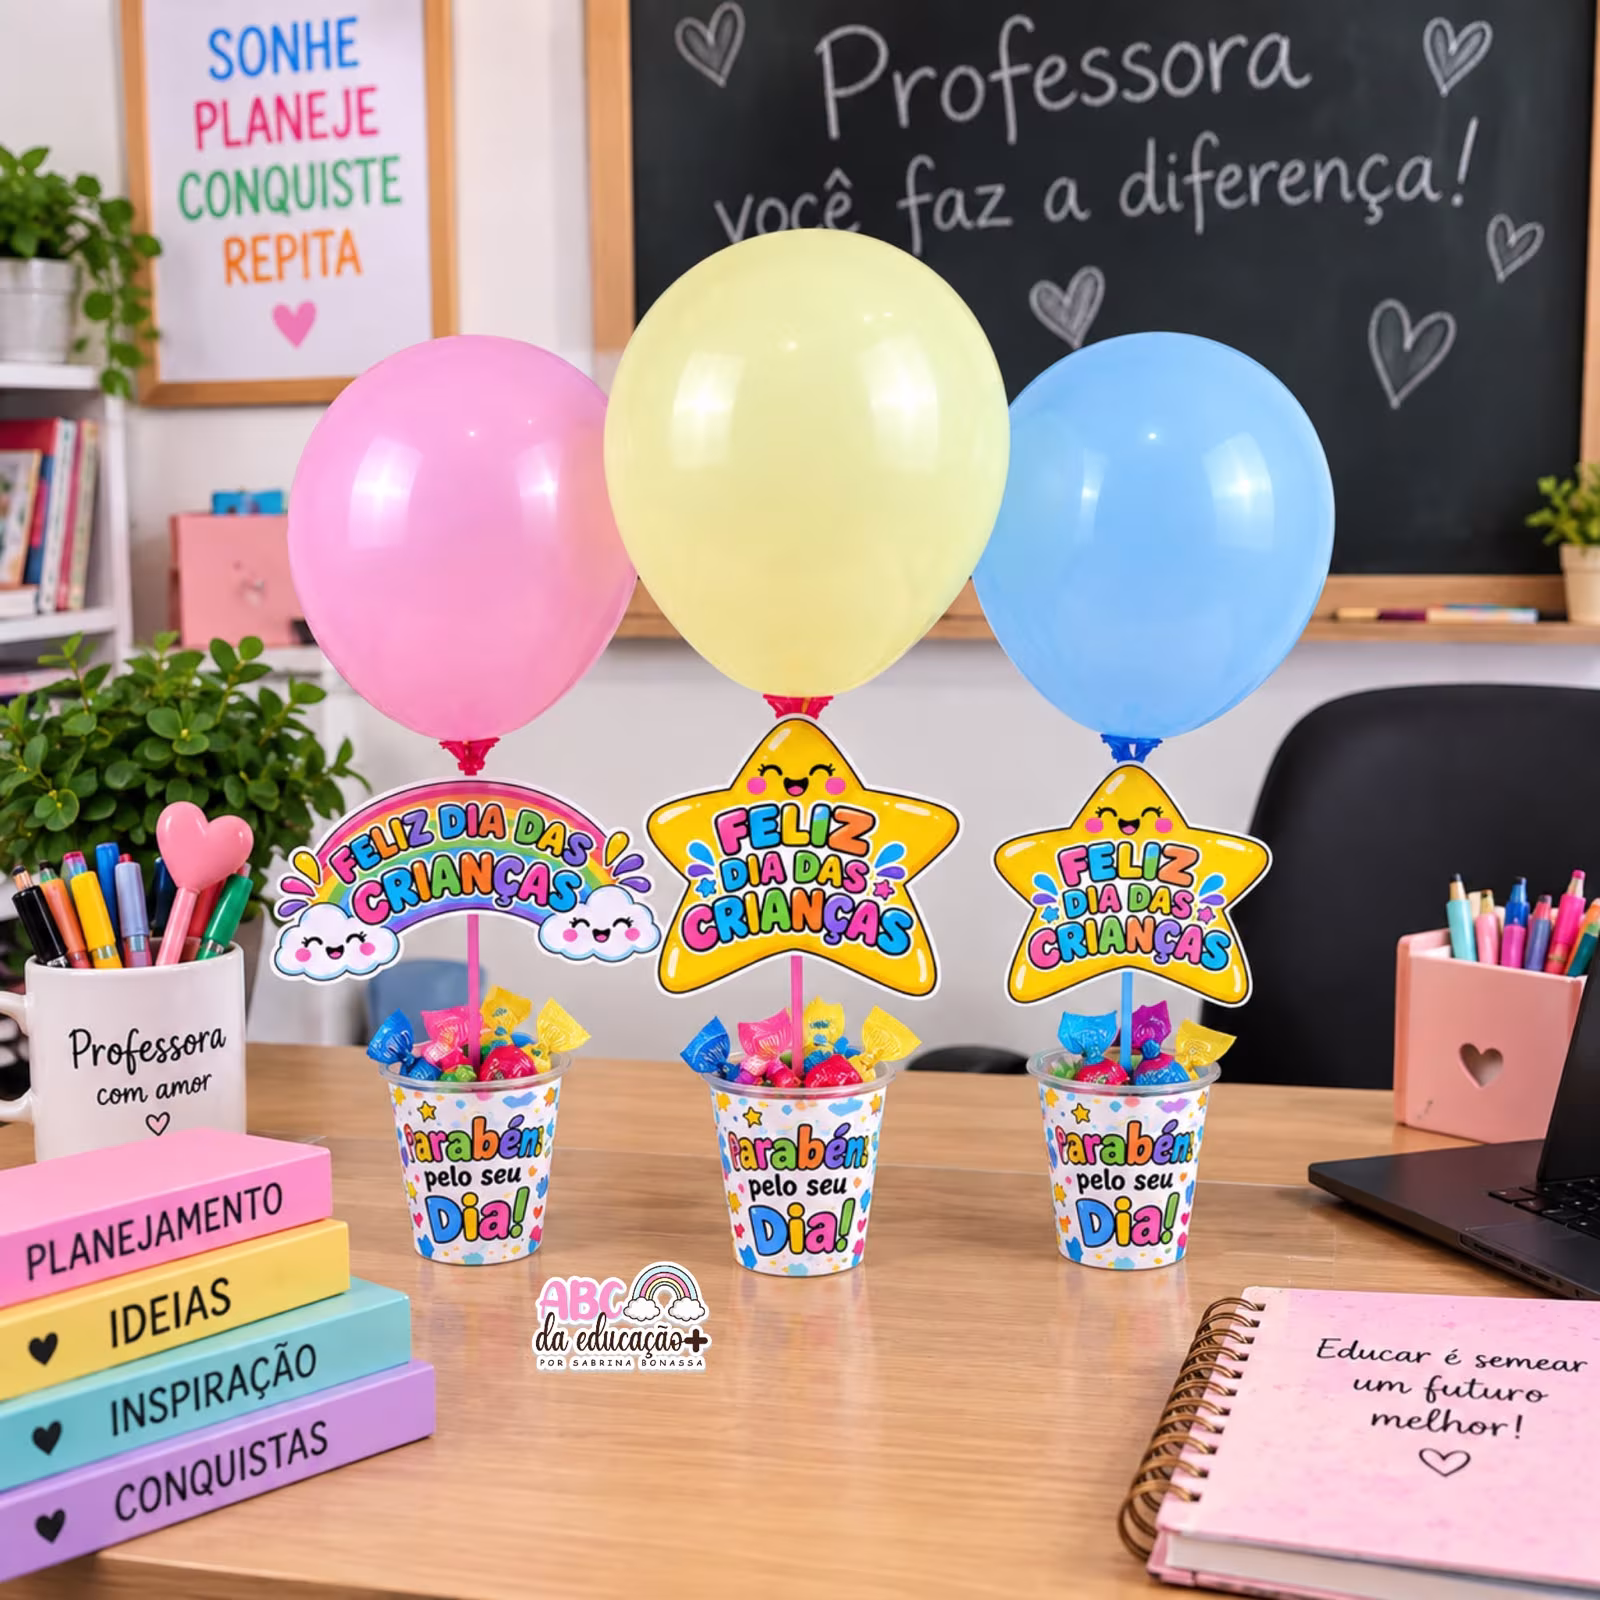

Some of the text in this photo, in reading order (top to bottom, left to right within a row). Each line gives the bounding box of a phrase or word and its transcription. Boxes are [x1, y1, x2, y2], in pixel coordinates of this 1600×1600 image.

[208, 16, 360, 81] SONHE
[815, 13, 1311, 141] Professora
[194, 86, 379, 151] PLANEJE
[178, 155, 402, 222] CONQUISTE
[714, 116, 1478, 257] você faz a diferença!
[223, 228, 362, 286] REPITA
[329, 803, 593, 884] FELIZ DIA DAS
[715, 803, 875, 857] FELIZ
[352, 852, 583, 925] CRIANÇAS
[720, 850, 869, 894] DIA DAS
[1057, 841, 1199, 887] FELIZ
[682, 888, 913, 956] CRIANÇAS
[1063, 883, 1194, 919] DIA DAS
[1028, 915, 1231, 971] CRIANÇAS
[69, 1028, 226, 1076] Professora
[97, 1073, 212, 1105] com amor
[424, 1166, 521, 1192] pelo seu
[749, 1174, 847, 1201] pelo seu
[1077, 1169, 1173, 1194] pelo seu
[26, 1182, 283, 1281] PLANEJAMENTO
[425, 1187, 530, 1244] Dia!
[749, 1198, 855, 1256] Dia!
[1076, 1192, 1180, 1248] Dia!
[110, 1277, 231, 1348] IDEIAS
[1316, 1338, 1588, 1373] Educar é semear
[111, 1342, 316, 1436] INSPIRAÇÃO
[1353, 1375, 1549, 1403] um futuro
[1371, 1409, 1523, 1439] melhor!
[114, 1421, 328, 1521] CONQUISTAS
